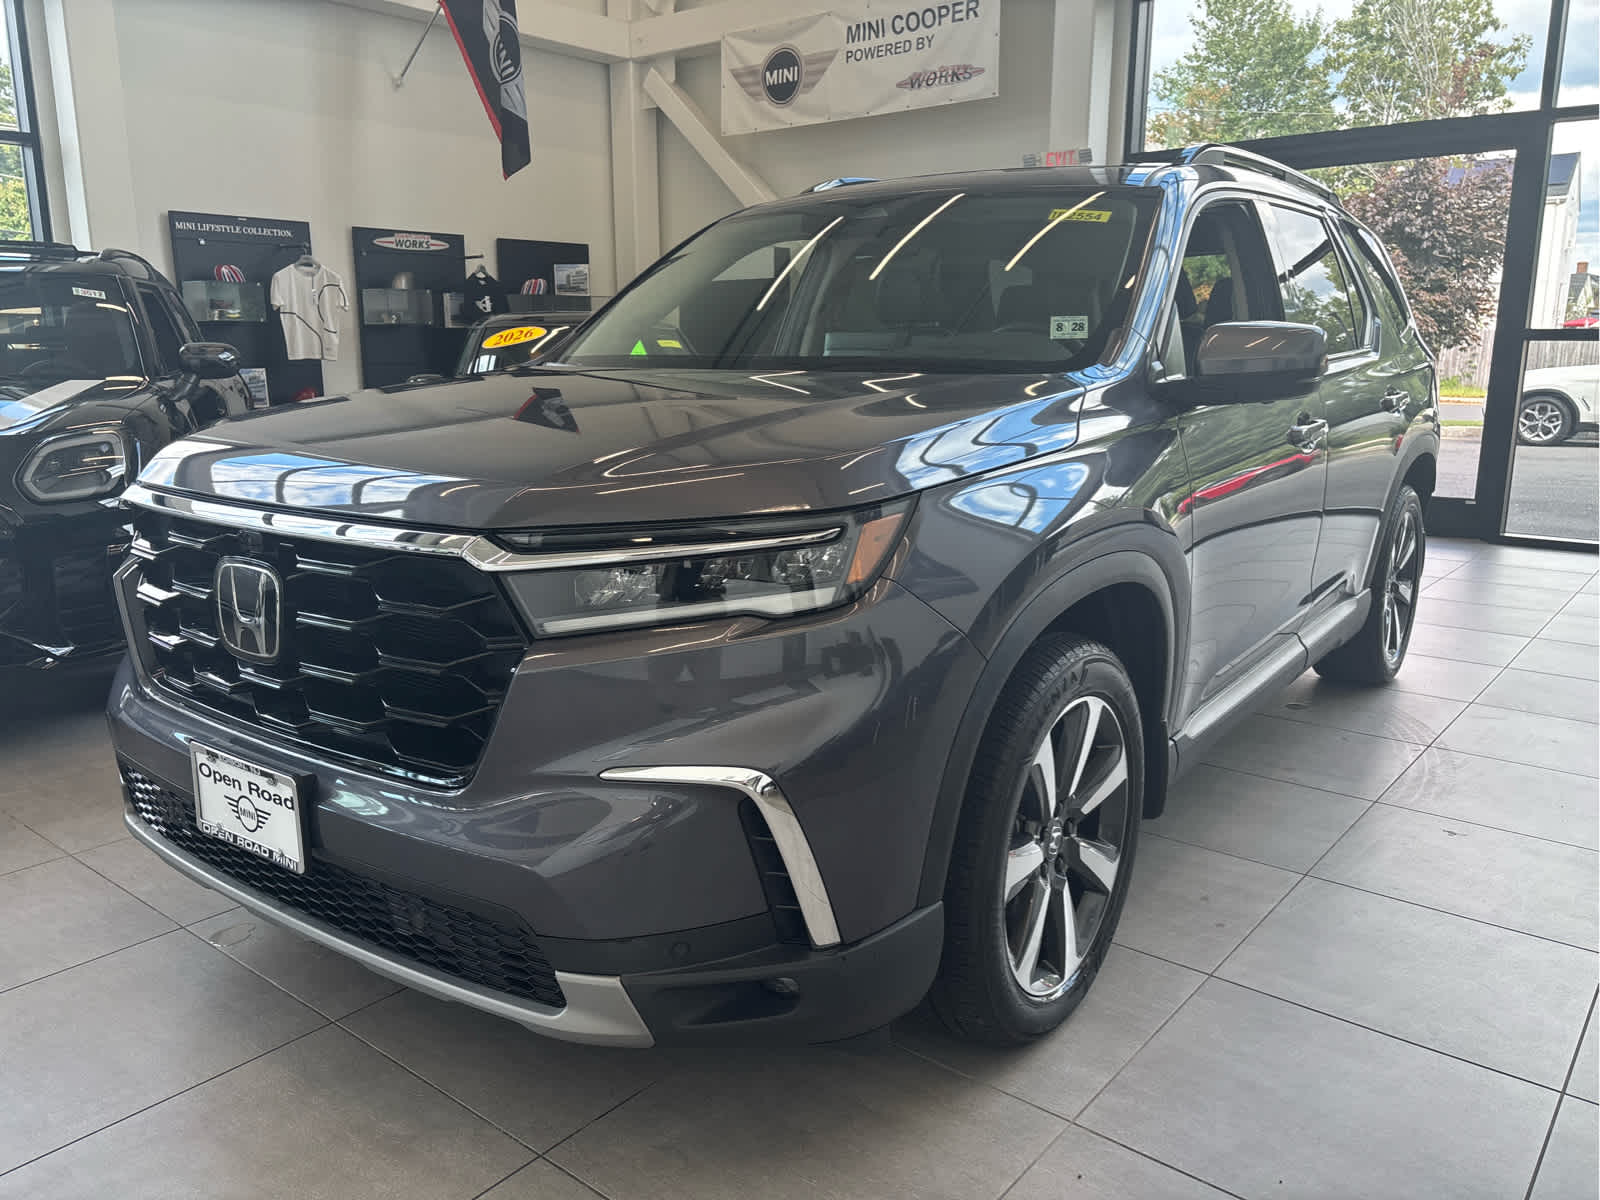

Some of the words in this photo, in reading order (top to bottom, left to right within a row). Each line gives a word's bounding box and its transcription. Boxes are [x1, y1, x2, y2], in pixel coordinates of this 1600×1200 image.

[846, 18, 886, 45] MINI
[891, 0, 980, 35] COOPER
[845, 39, 912, 63] POWERED
[916, 34, 935, 50] BY
[765, 66, 798, 87] MINI
[175, 221, 196, 231] MINI
[198, 223, 242, 234] LIFESTYLE
[242, 226, 293, 238] COLLECTION
[394, 239, 431, 249] WORKS
[1055, 322, 1065, 333] 8
[1071, 322, 1086, 332] 28
[493, 329, 534, 346] 2026
[199, 762, 242, 791] Open
[248, 781, 296, 812] Road
[240, 807, 257, 822] MINI
[202, 823, 235, 843] OPEN
[236, 838, 270, 858] ROAD
[272, 851, 298, 872] MINI
